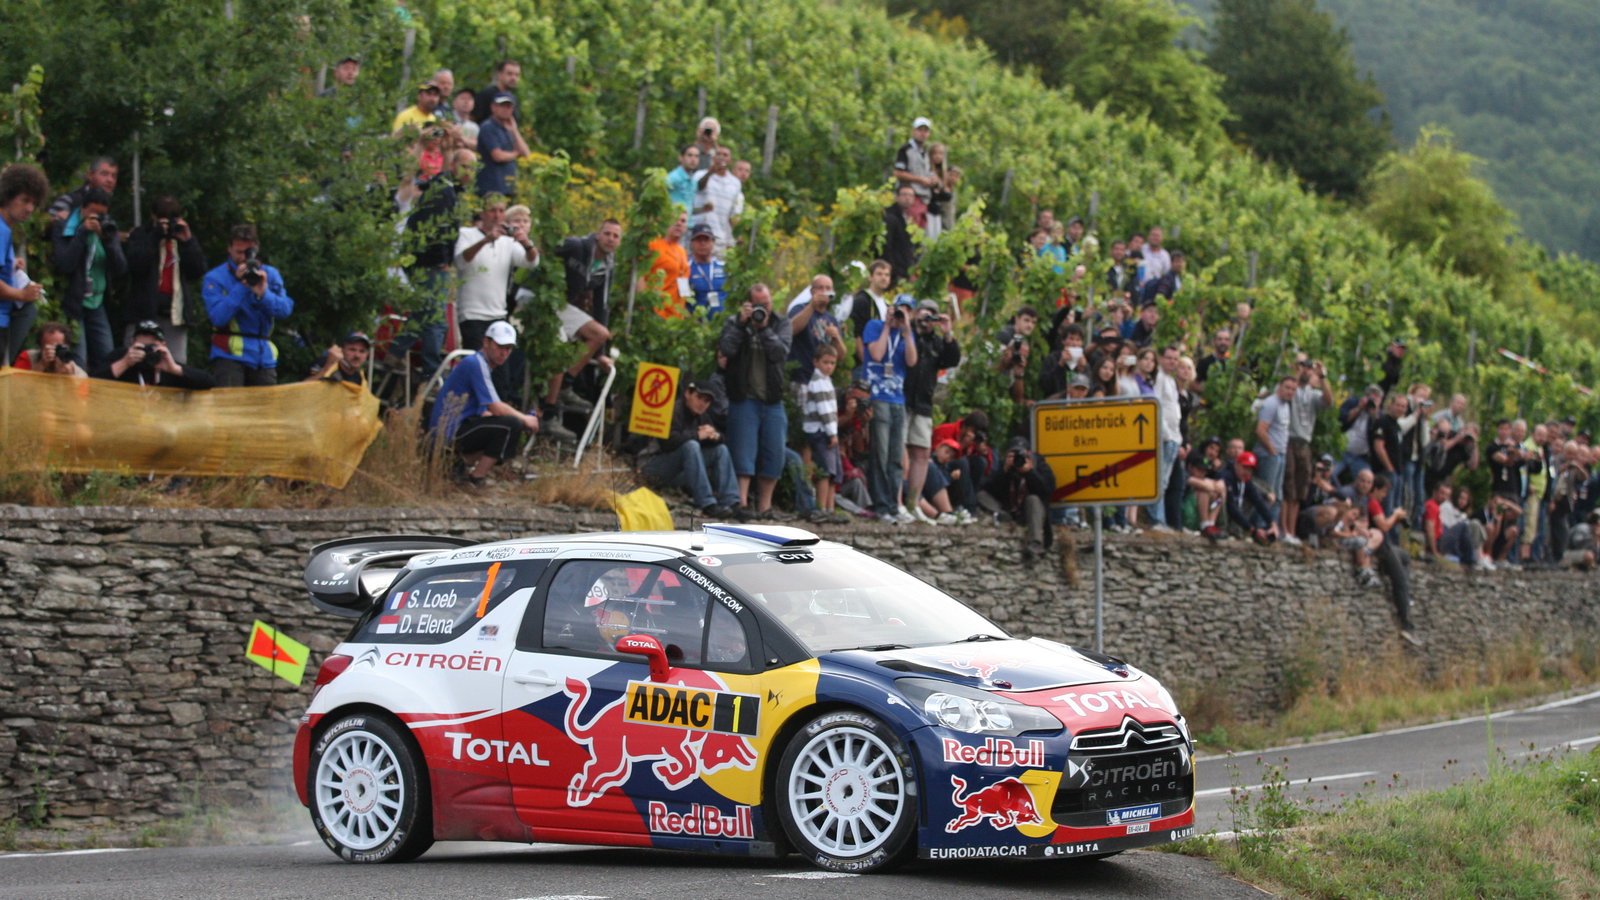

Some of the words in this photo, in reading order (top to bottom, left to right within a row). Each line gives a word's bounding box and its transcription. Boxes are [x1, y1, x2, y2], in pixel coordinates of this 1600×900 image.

[1045, 413, 1127, 431] Büdlicherbrück
[1075, 464, 1119, 488] Fell
[407, 591, 420, 609] S.
[422, 589, 456, 610] Loeb
[476, 562, 501, 618] 1
[679, 564, 743, 614] CITROEN-WRC.COM
[400, 615, 413, 634] D.
[415, 614, 454, 634] Elena
[626, 640, 656, 649] TOTAL
[385, 651, 501, 672] CITROËN
[628, 686, 711, 728] ADAC
[731, 696, 742, 733] 1
[1052, 689, 1161, 717] TOTAL
[324, 717, 365, 743] MICHELIN
[820, 714, 876, 729] MICHELIN
[444, 732, 550, 767] TOTAL
[1088, 781, 1176, 801] RACING
[1121, 806, 1159, 819] MICHELIN
[930, 845, 1027, 859] EURODATACAR
[1057, 843, 1099, 854] LUHTA
